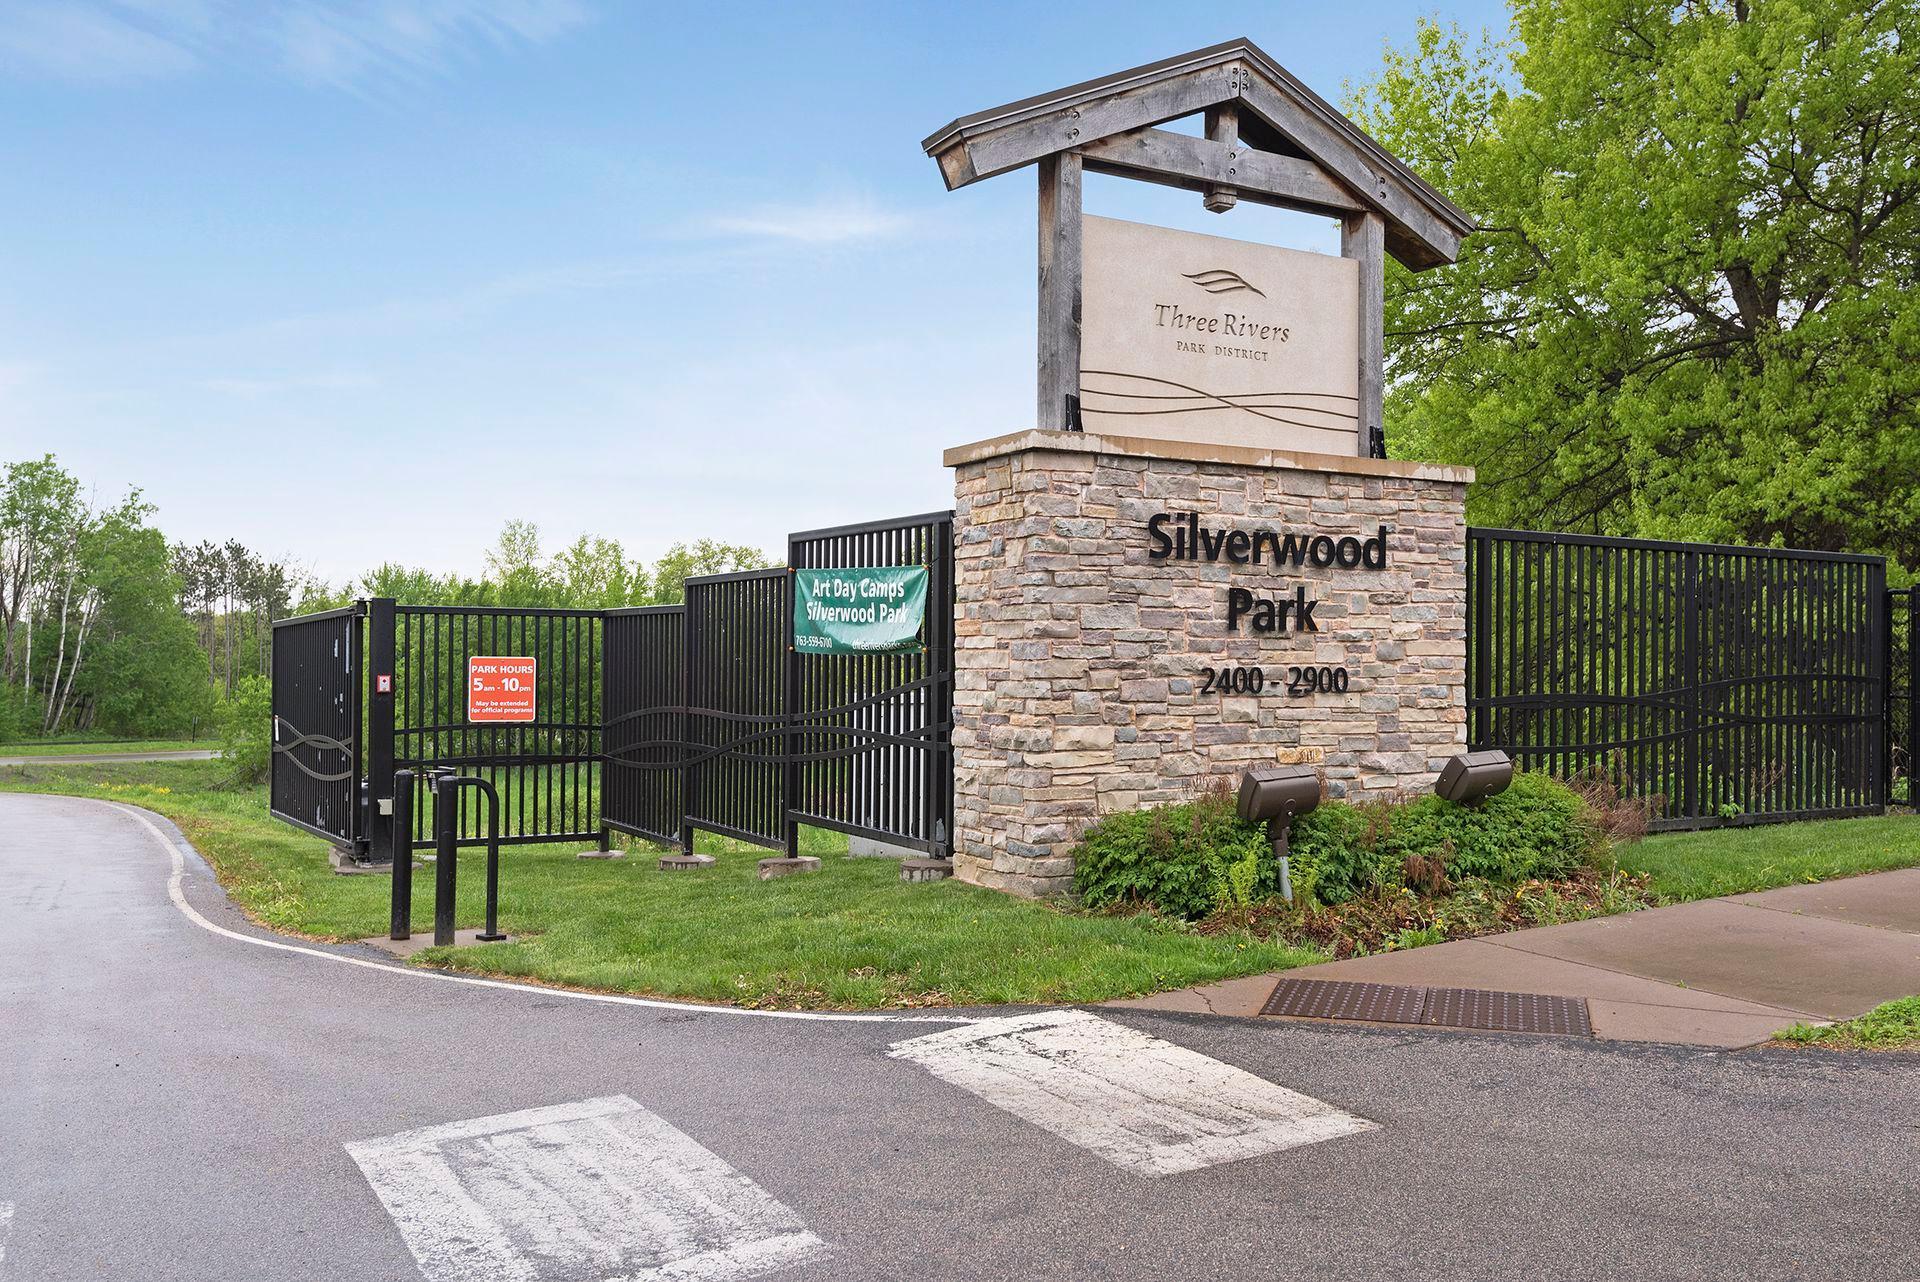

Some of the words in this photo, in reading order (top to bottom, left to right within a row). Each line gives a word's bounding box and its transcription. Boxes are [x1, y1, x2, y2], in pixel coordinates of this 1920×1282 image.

[1154, 303, 1218, 333] Three
[1222, 313, 1290, 343] Rivers
[1176, 340, 1206, 354] PARK
[1215, 345, 1269, 362] DISTRICT
[1148, 512, 1387, 570] Silverwood
[812, 579, 831, 597] Art
[834, 579, 857, 602] Day
[861, 578, 905, 603] Camps
[806, 602, 875, 623] Silverwood
[879, 602, 908, 624] Park
[1228, 586, 1319, 632] Park
[471, 665, 498, 673] PARK
[500, 665, 534, 673] HOURS
[1200, 666, 1264, 695] 2400
[1287, 666, 1349, 695] 2900
